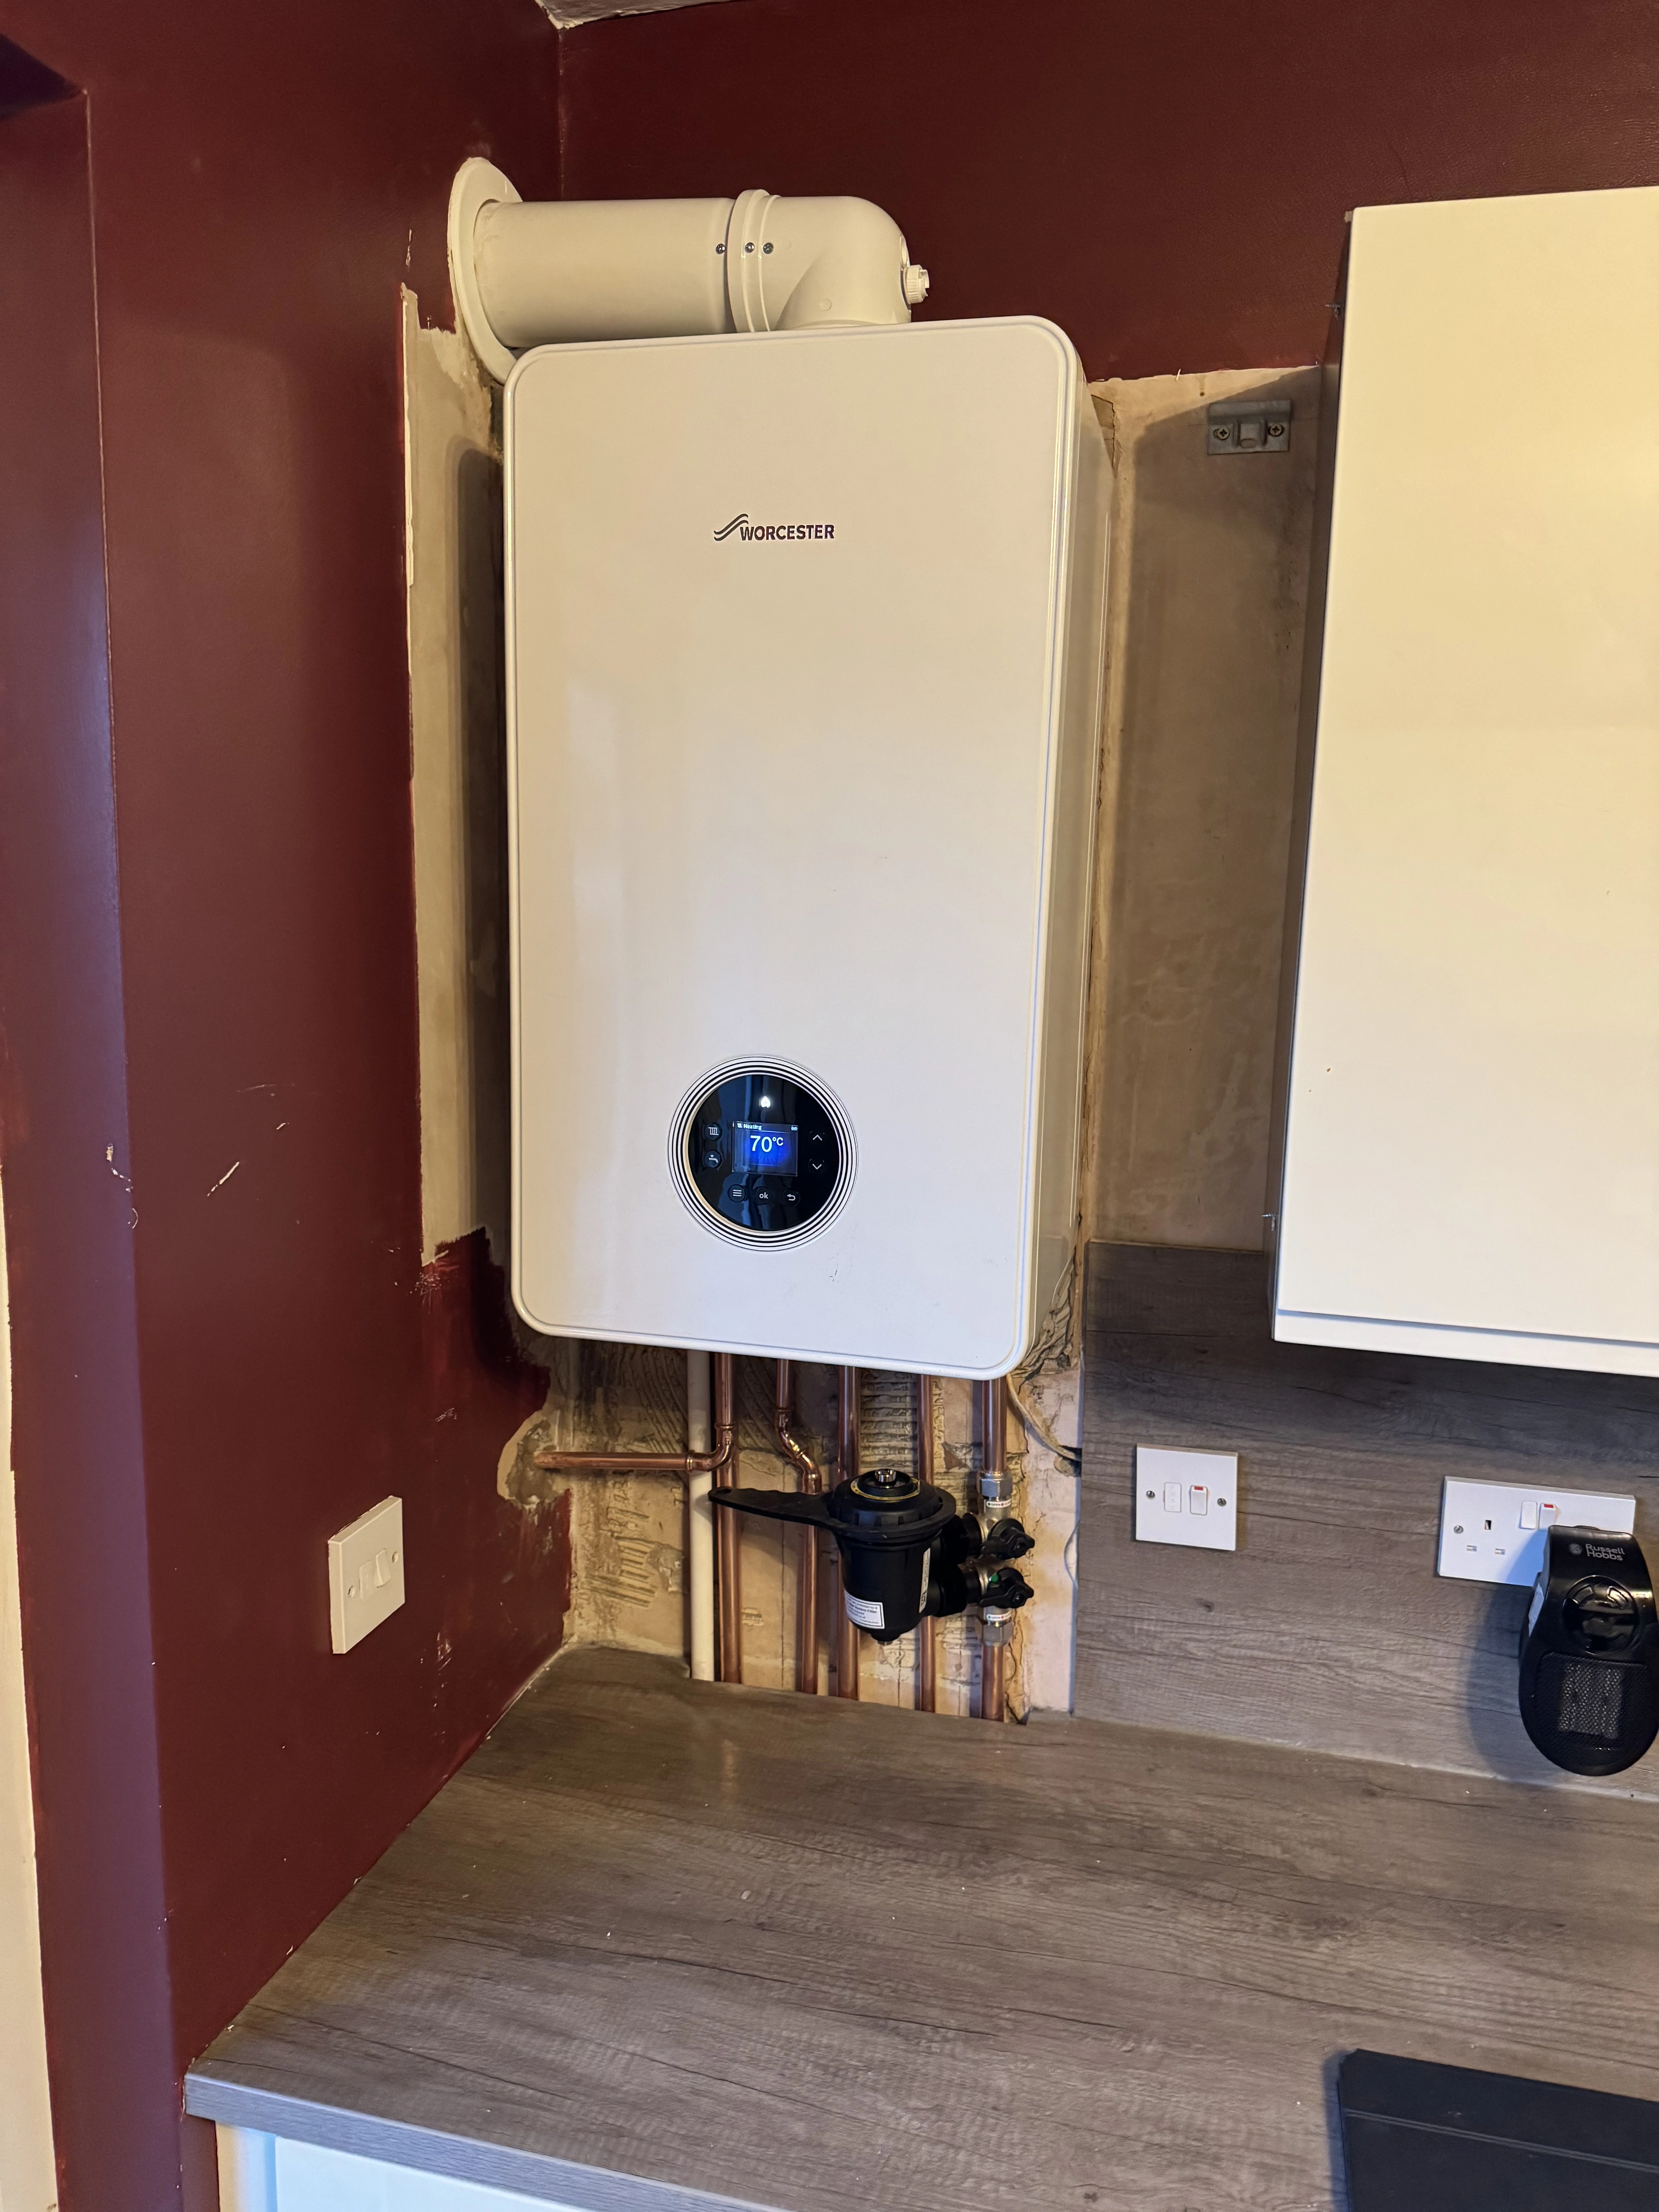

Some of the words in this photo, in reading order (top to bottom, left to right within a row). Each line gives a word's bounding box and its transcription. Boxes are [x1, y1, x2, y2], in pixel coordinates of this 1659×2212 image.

[740, 525, 835, 541] WORCESTER
[750, 1135, 783, 1152] 70°C
[1585, 1544, 1625, 1554] Russell
[1587, 1549, 1623, 1561] Hobbs
